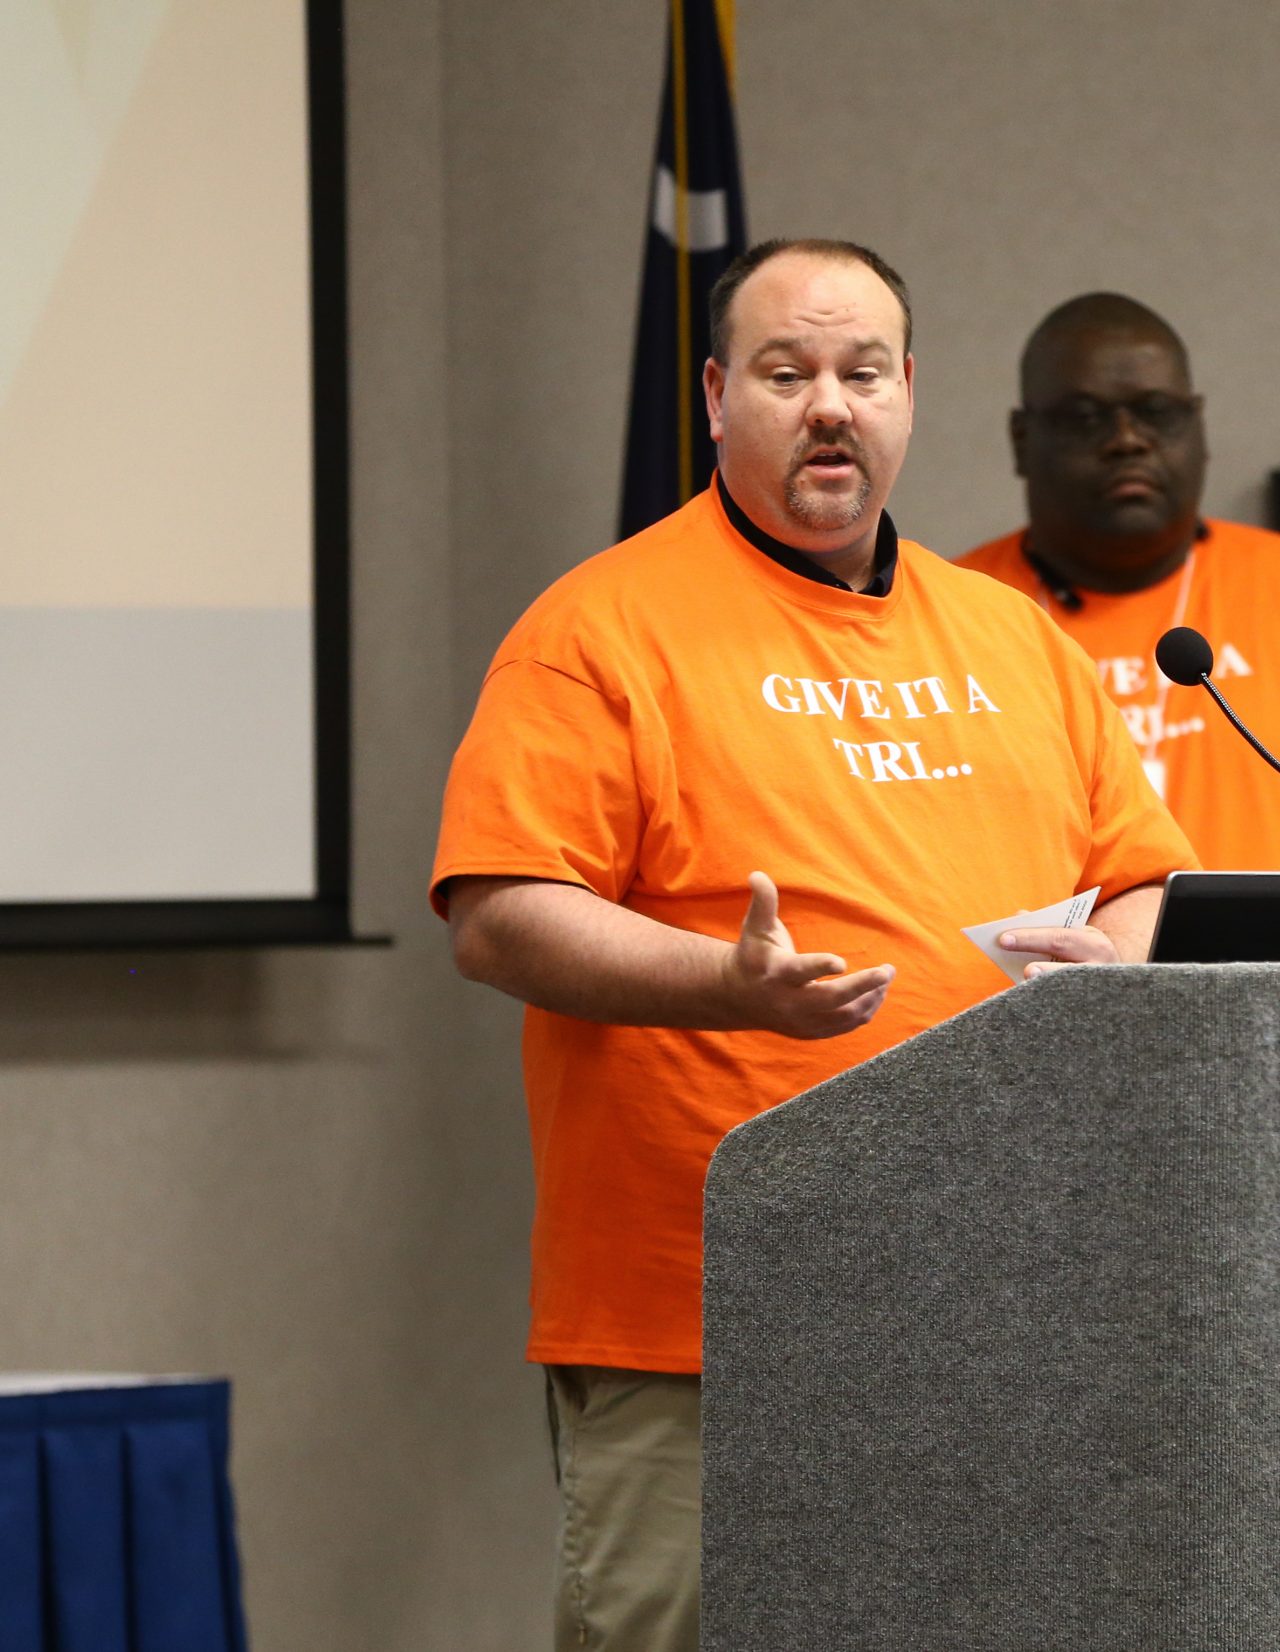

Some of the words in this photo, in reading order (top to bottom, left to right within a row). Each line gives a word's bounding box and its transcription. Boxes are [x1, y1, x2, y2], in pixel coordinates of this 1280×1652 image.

[761, 673, 891, 721] GIVE
[893, 676, 954, 719] IT
[966, 674, 1002, 714] A
[832, 737, 973, 783] TRI...
